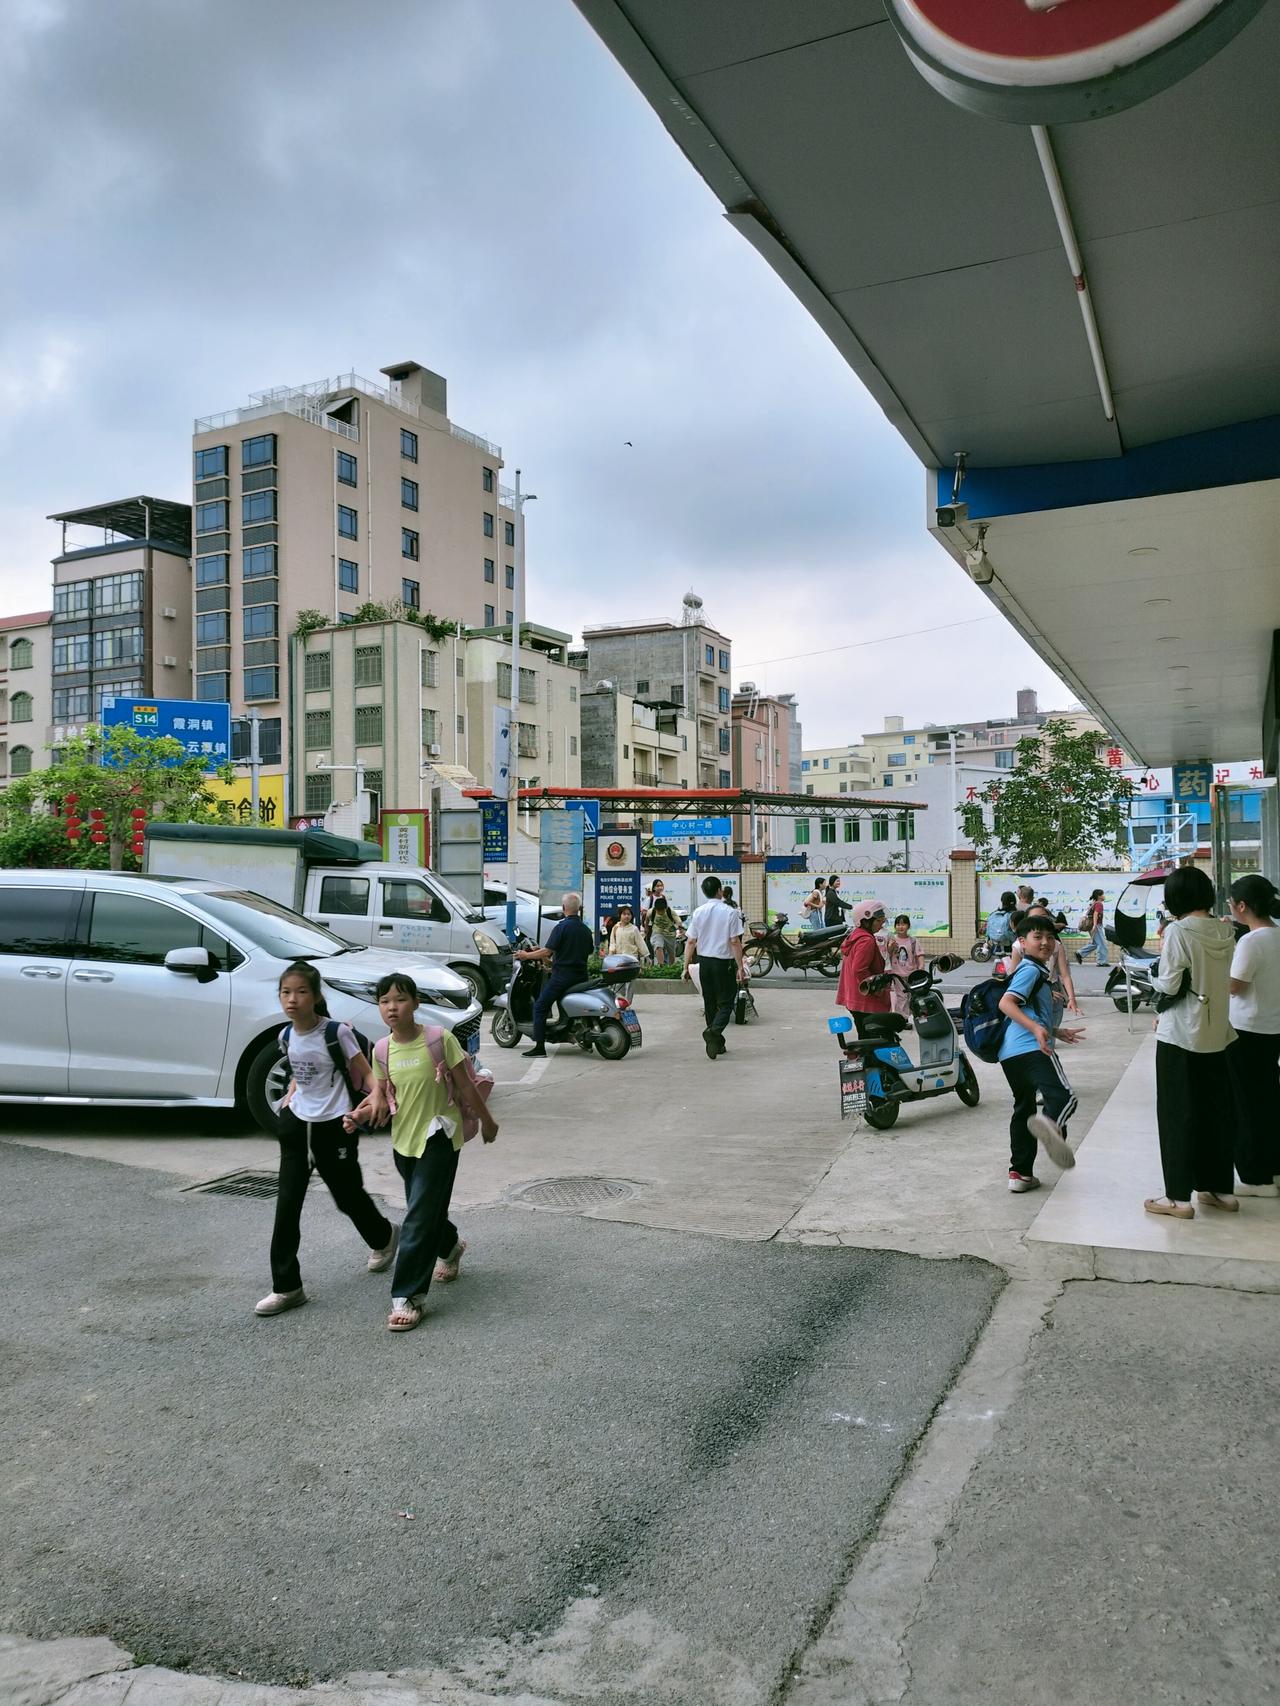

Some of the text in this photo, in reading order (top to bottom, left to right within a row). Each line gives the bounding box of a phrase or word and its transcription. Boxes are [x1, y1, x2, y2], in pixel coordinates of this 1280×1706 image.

[135, 713, 157, 724] S14
[173, 717, 214, 731] 霞洞镇
[1179, 769, 1208, 797] 药
[671, 821, 713, 830] 中心村一路
[396, 1058, 420, 1068] HELLO
